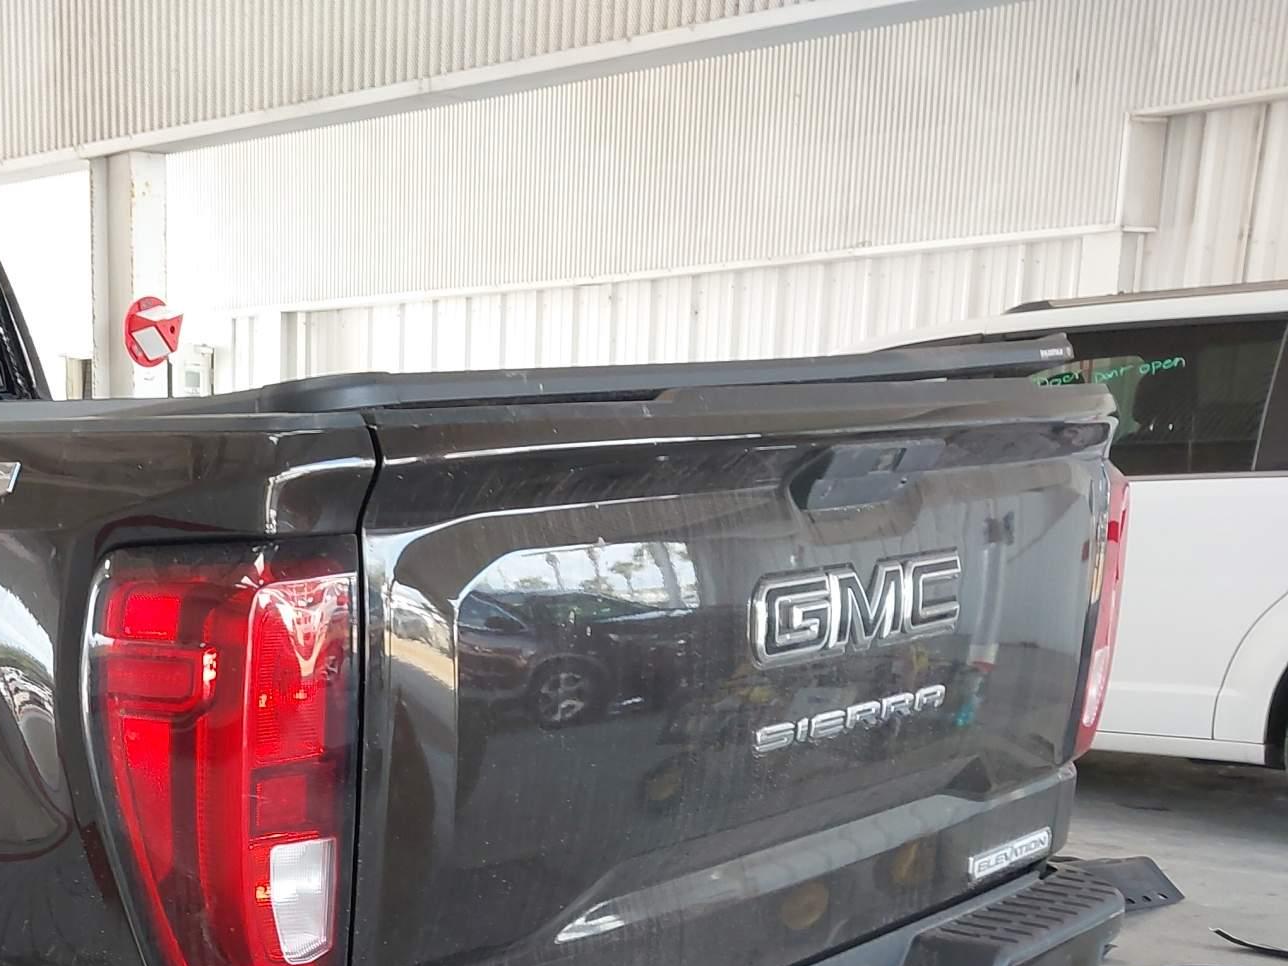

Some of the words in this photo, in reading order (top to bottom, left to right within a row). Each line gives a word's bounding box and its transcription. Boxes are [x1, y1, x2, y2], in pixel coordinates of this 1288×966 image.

[1138, 356, 1186, 375] open
[748, 547, 961, 670] GMC
[754, 684, 946, 752] SIERRA
[977, 836, 1047, 873] ELEVATION
